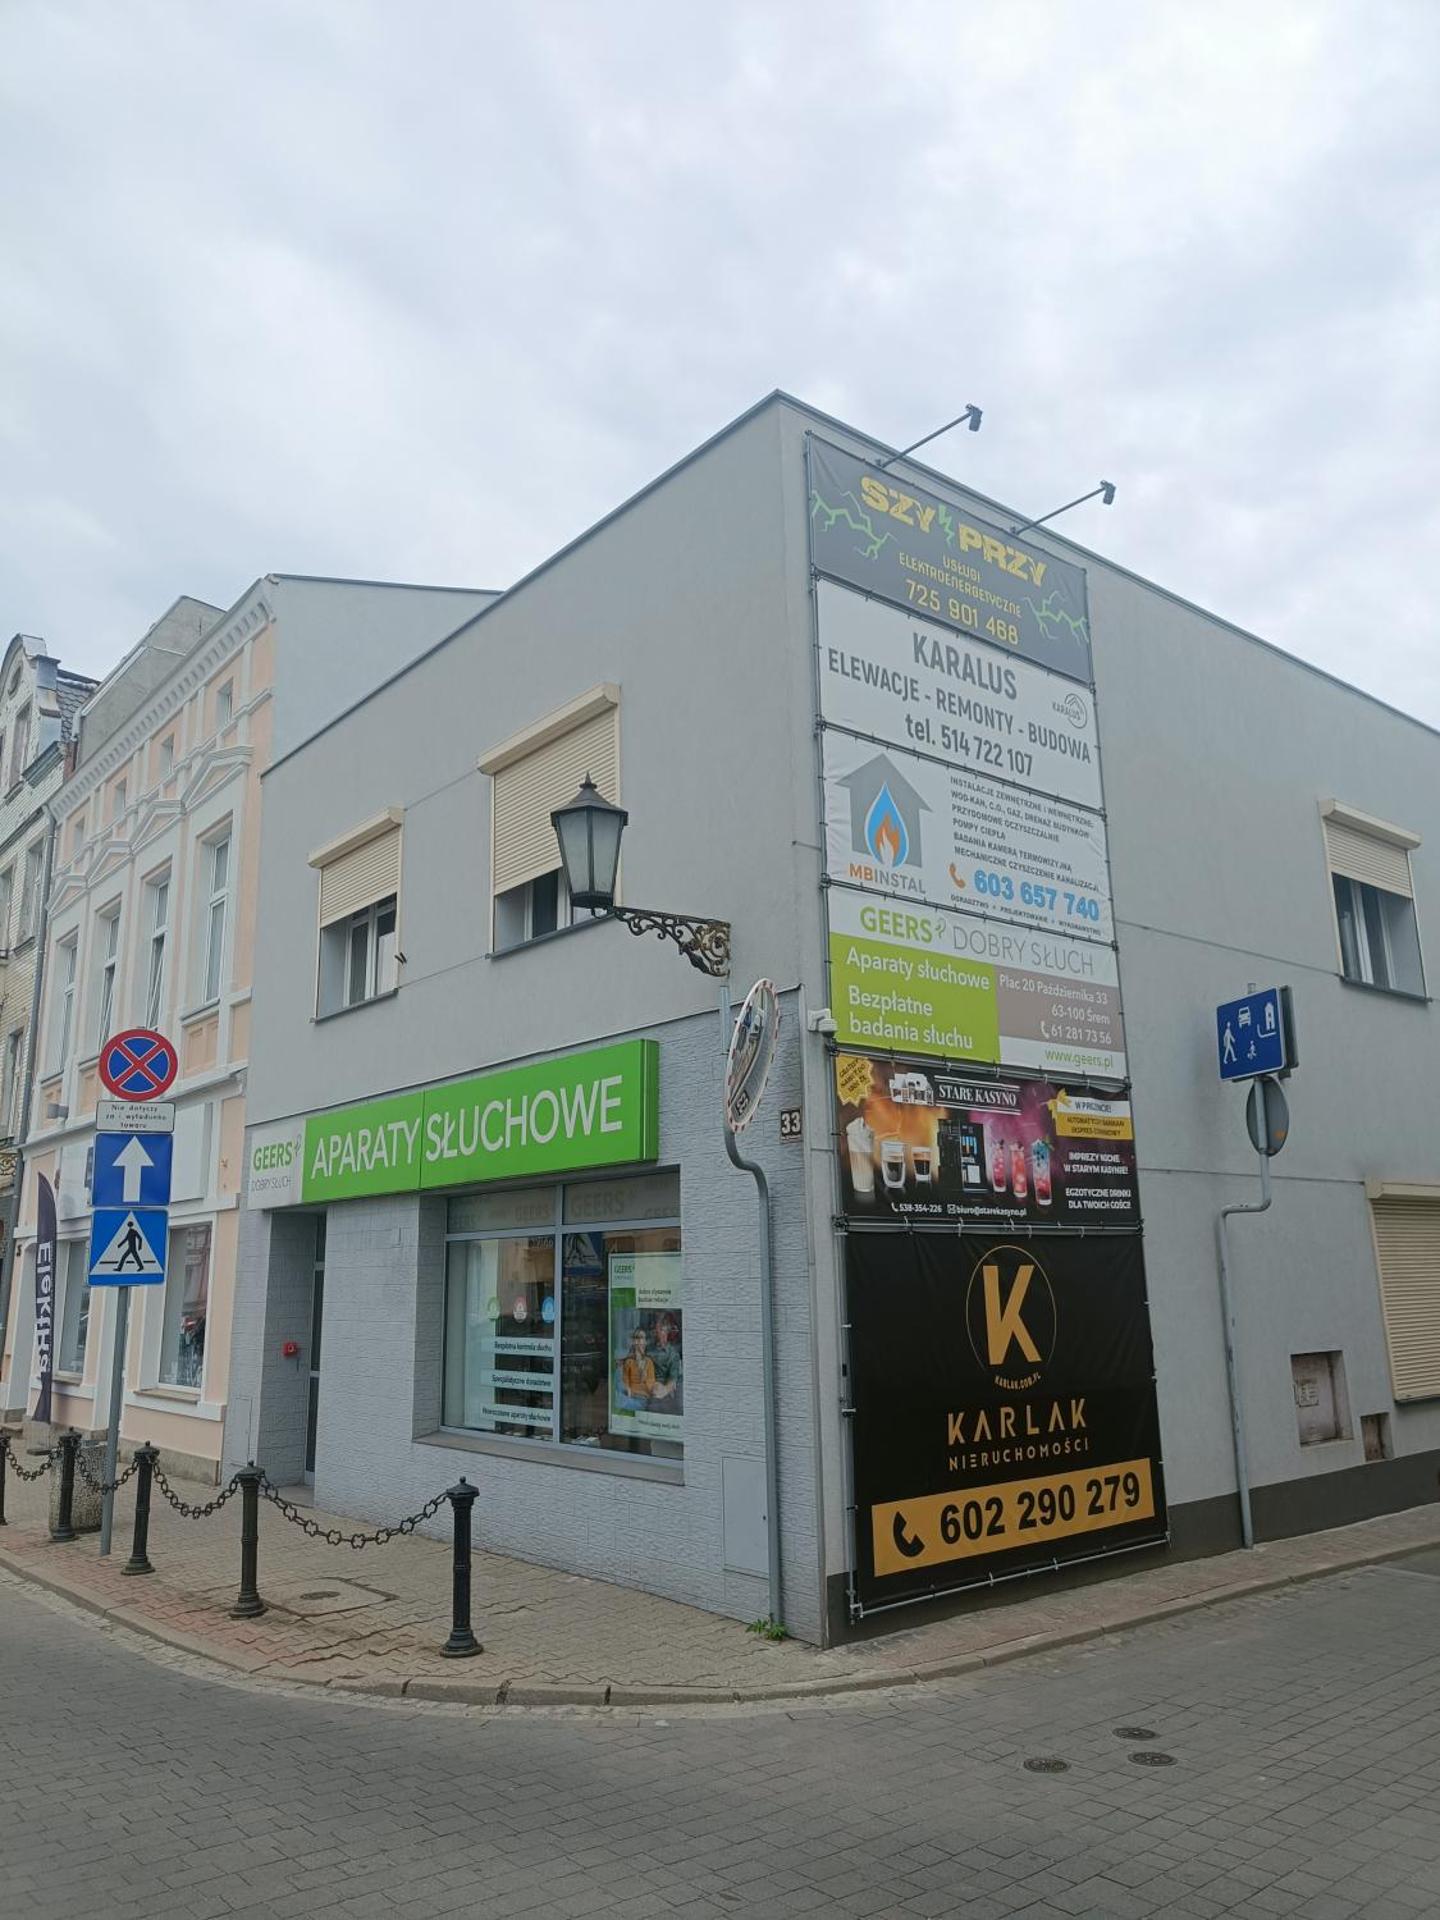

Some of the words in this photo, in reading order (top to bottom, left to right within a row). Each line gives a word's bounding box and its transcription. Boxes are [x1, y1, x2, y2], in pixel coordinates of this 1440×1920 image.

[861, 476, 936, 533] SZY
[958, 523, 1047, 586] PRZY
[899, 552, 1022, 618] ELEKTROENERGETYCZNE
[943, 556, 981, 581] USŁUGI
[906, 579, 941, 612] 725
[949, 599, 978, 629] 901
[986, 616, 1019, 645] 468
[913, 632, 1017, 700] KARALUS
[828, 648, 919, 702] ELEWACJE
[936, 687, 1014, 735] REMONTY
[1028, 723, 1091, 764] BUDOWA
[906, 713, 936, 745] tel.
[941, 726, 970, 756] 514
[973, 736, 1003, 767] 722
[1007, 749, 1033, 777] 107
[951, 776, 994, 797] INSTALACJE
[952, 804, 1003, 825] PRZYDOMOWE
[1004, 821, 1060, 842] OCZYSZCZALNIE
[953, 818, 978, 832] POMPY
[980, 826, 1006, 841] CIEPŁA
[953, 832, 986, 849] BADANIA
[954, 846, 1007, 867] MECHANICZNE
[849, 863, 927, 895] MBINSTAL
[974, 869, 1014, 900] 603
[1020, 882, 1057, 911] 657
[1064, 893, 1100, 921] 740
[860, 905, 933, 944] GEERS
[953, 926, 1026, 963] DOBRY
[1032, 941, 1094, 976] SŁUCH
[846, 946, 914, 982] Aparaty
[918, 959, 990, 990] słuchowe
[848, 984, 933, 1017] Bezpłatne
[999, 973, 1019, 990] Plac
[1022, 979, 1036, 991] 20
[1037, 980, 1094, 1003] Października
[1095, 991, 1108, 1005] 33
[850, 1012, 918, 1042] badania
[923, 1024, 973, 1050] słuchu
[1051, 1003, 1085, 1021] 63-100
[1087, 1006, 1110, 1025] Śrem
[1051, 1023, 1062, 1037] 61
[1065, 1025, 1083, 1041] 281
[1085, 1028, 1097, 1043] 73
[1099, 1030, 1111, 1045] 56
[1045, 1047, 1114, 1069] www.geers.pl
[129, 1105, 158, 1113] dotyczy
[938, 1085, 973, 1102] STARE
[975, 1089, 1017, 1107] KASYNO
[311, 1118, 421, 1180] APARATY
[426, 1075, 623, 1163] SŁUCHOWE
[781, 1111, 801, 1134] 33
[253, 1141, 293, 1171] GEERS
[1069, 1201, 1083, 1209] DLA
[983, 1265, 1042, 1366] K
[947, 1398, 1088, 1446] KARLAK
[949, 1437, 1089, 1472] NIERUCHOMOŚCI
[940, 1496, 1004, 1545] 602
[1017, 1484, 1075, 1530] 290
[1086, 1471, 1140, 1516] 279
